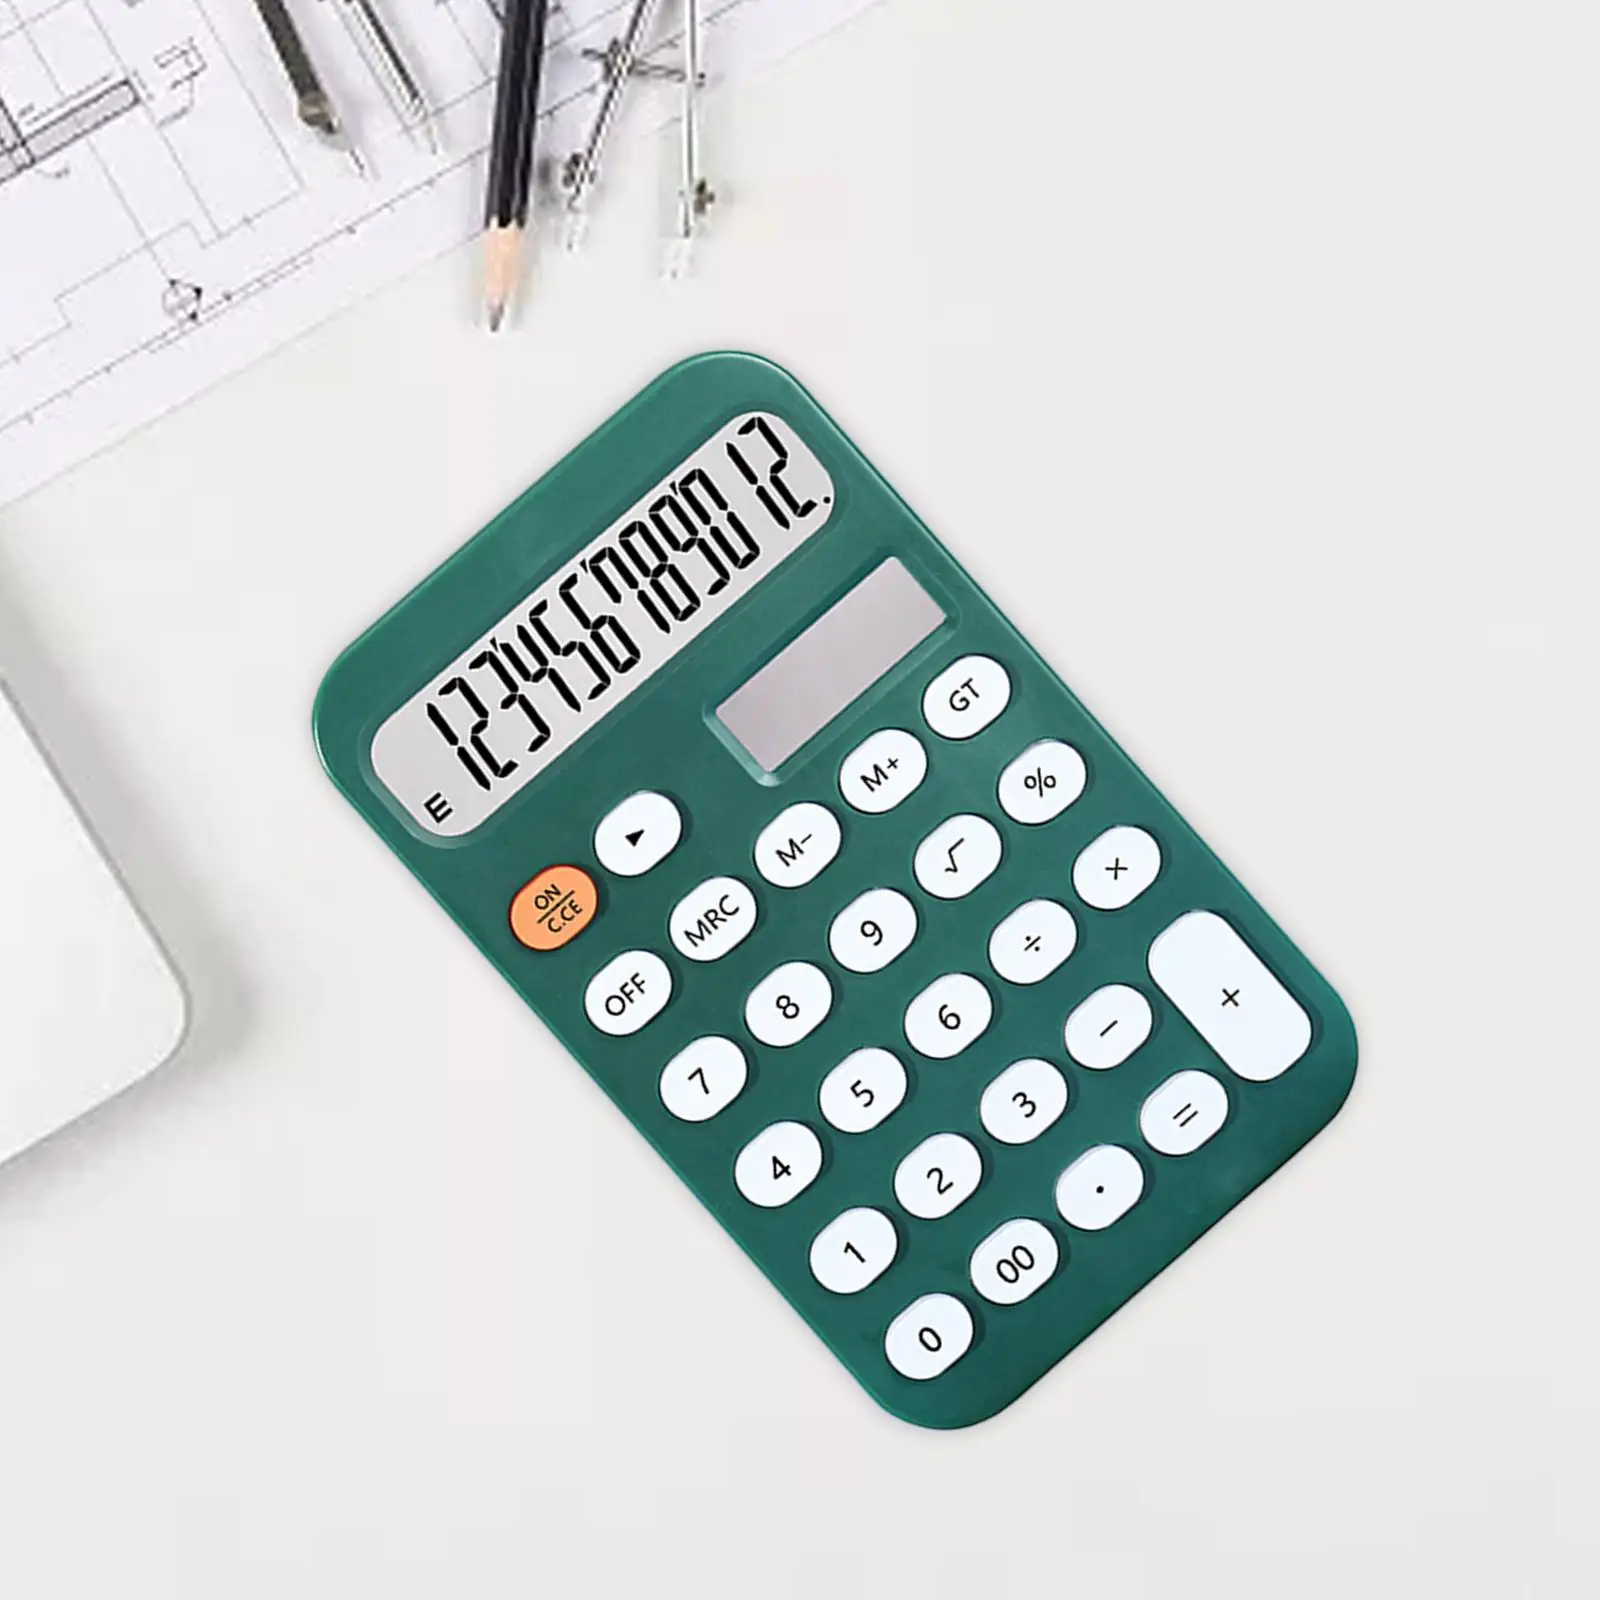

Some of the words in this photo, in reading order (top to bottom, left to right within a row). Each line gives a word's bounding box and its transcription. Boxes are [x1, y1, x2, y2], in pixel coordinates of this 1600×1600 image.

[950, 678, 979, 711] GT
[860, 759, 898, 792] M+
[424, 793, 453, 824] E
[534, 883, 562, 910] ON
[547, 899, 583, 933] C.CE
[684, 895, 739, 946] MRC
[861, 921, 883, 946] 9
[605, 973, 645, 1016] OFF
[776, 995, 799, 1019] 8
[939, 1004, 960, 1030] 6
[688, 1068, 709, 1094] 7
[851, 1080, 874, 1107] 5
[1012, 1092, 1036, 1118] 3
[772, 1156, 791, 1179] 4
[927, 1168, 953, 1194] 2
[844, 1242, 865, 1263] 1
[996, 1246, 1034, 1283] 00
[919, 1327, 942, 1352] 0
